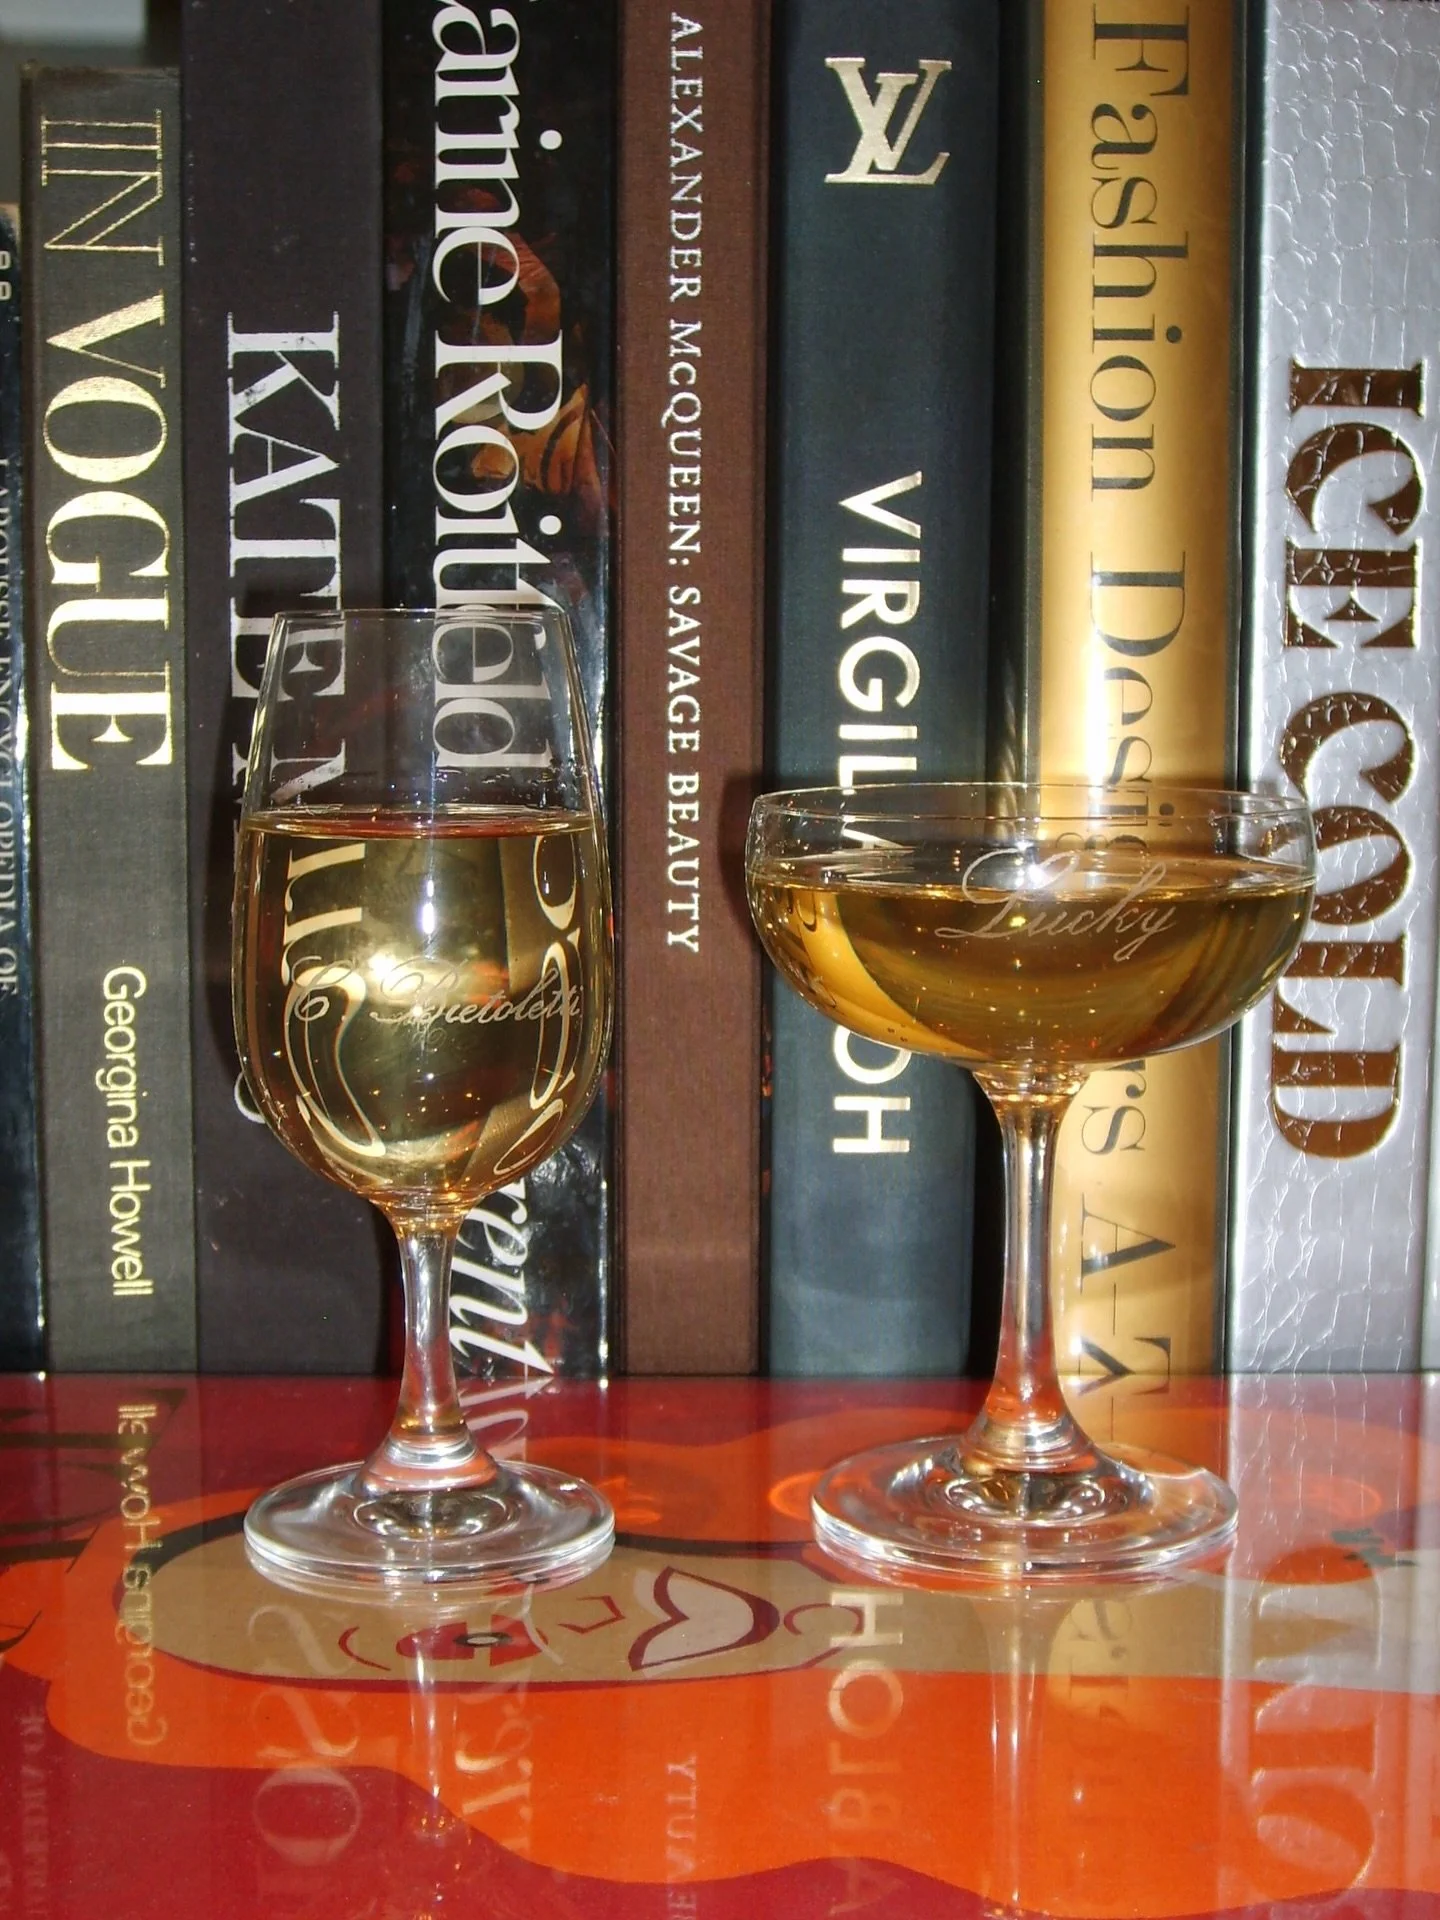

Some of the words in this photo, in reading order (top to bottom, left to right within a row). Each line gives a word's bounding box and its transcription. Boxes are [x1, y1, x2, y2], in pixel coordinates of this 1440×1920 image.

[41, 108, 164, 266] IN
[432, 0, 564, 306] arine
[669, 11, 704, 303] ALEXANDER
[1090, 4, 1192, 502] Fashion
[43, 289, 172, 772] VOGUE
[226, 310, 347, 702] KATE
[837, 470, 923, 798] VIRGIL
[1283, 357, 1428, 650] ICE
[667, 585, 702, 754] SAVAGE
[666, 772, 700, 954] BEAUTY
[934, 847, 1177, 963] Lucky
[1259, 691, 1418, 1160] COLD
[96, 964, 148, 1151] Georgina
[109, 1158, 154, 1297] Howell
